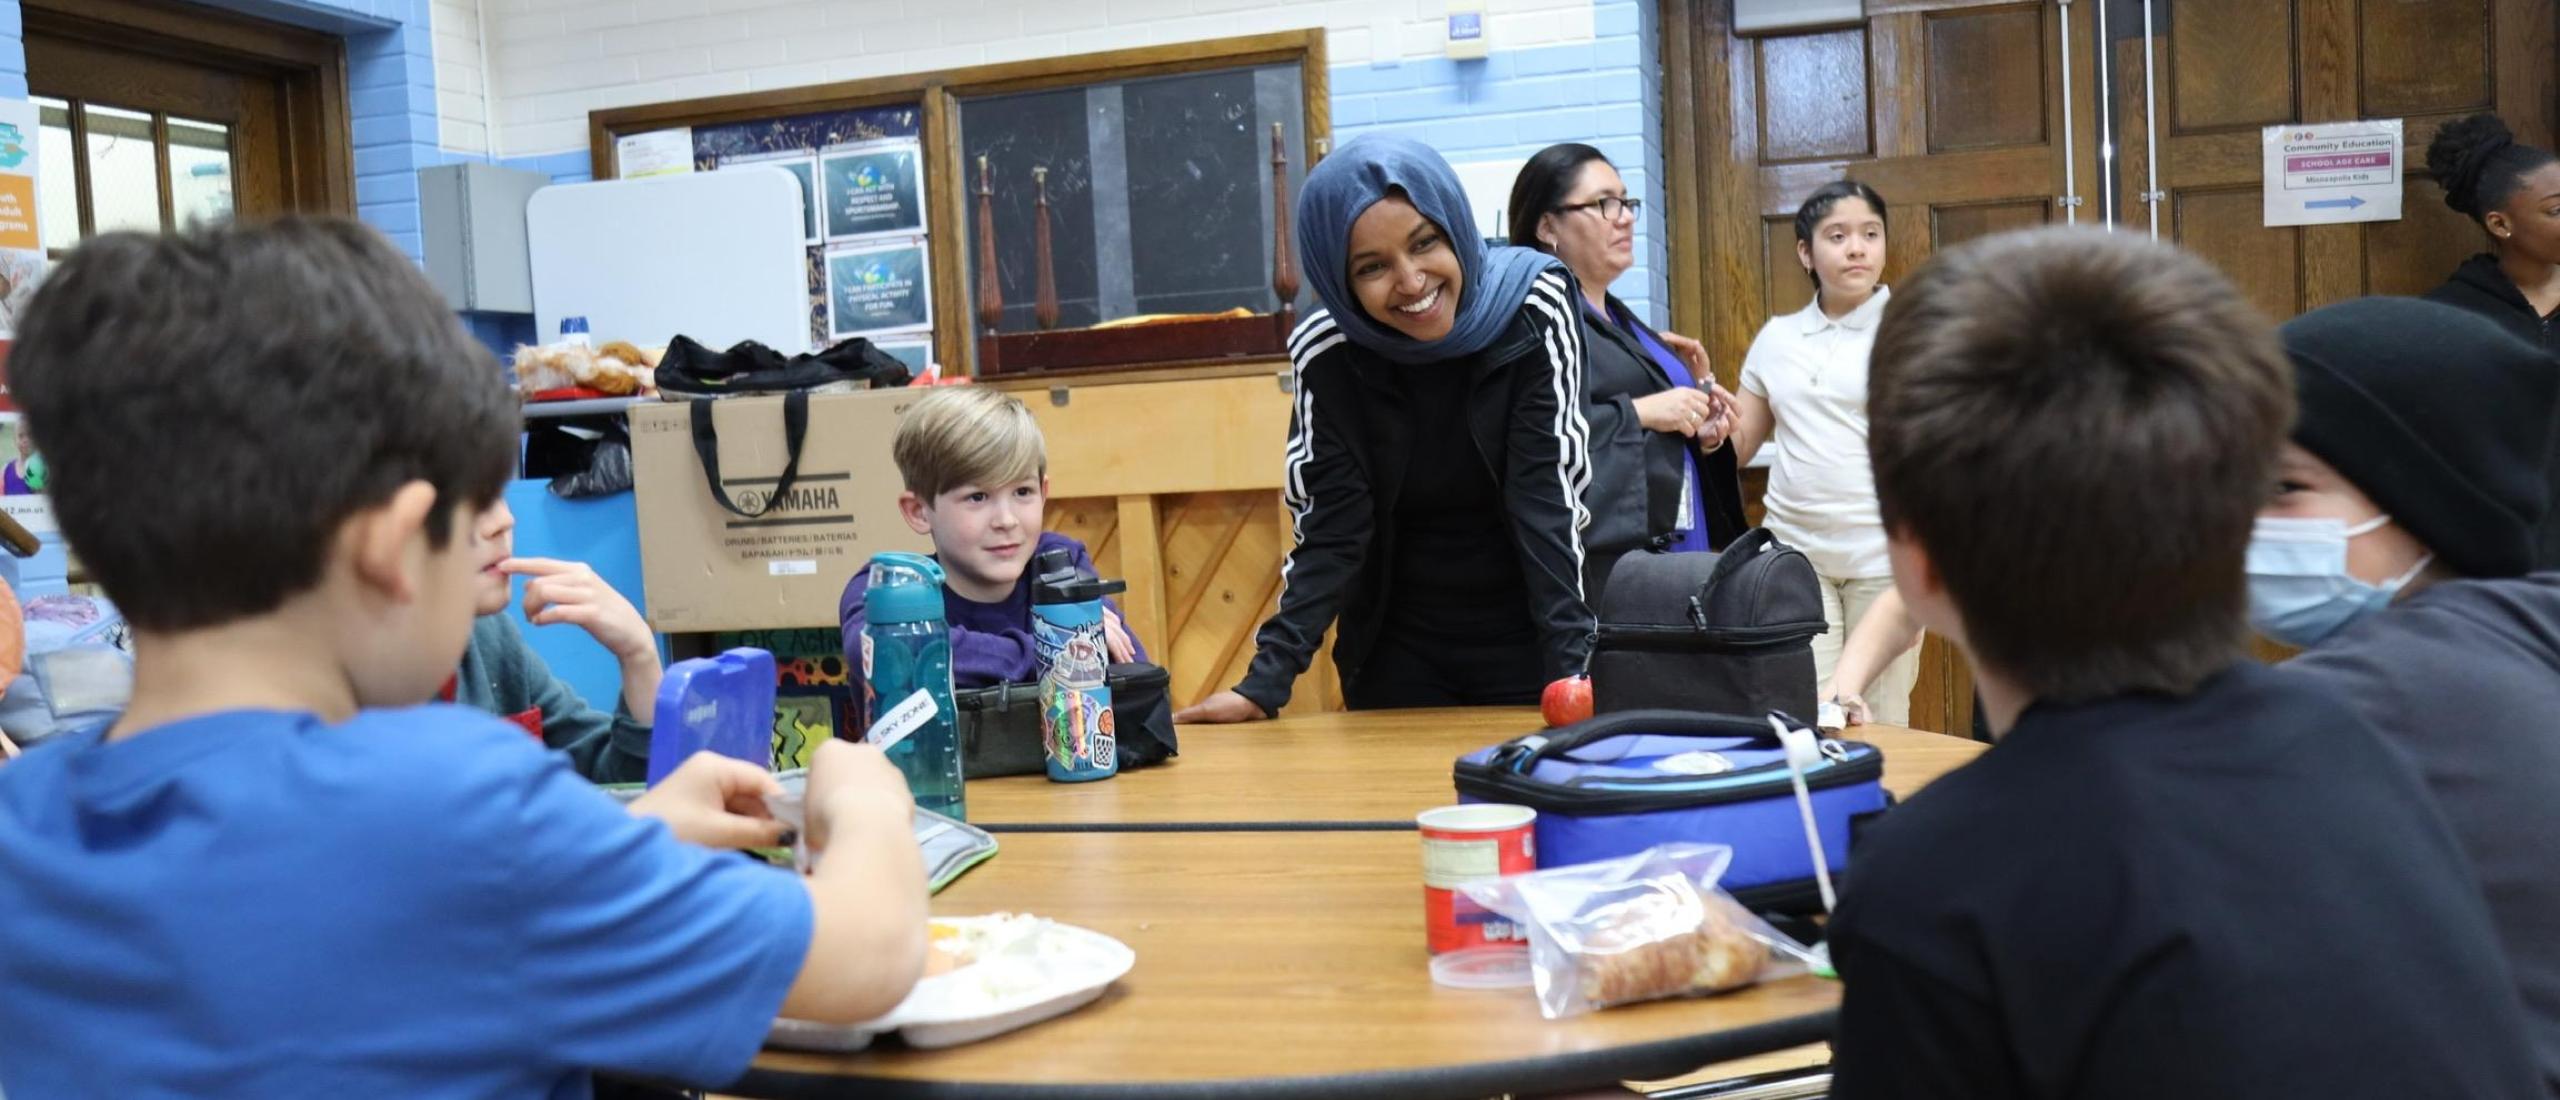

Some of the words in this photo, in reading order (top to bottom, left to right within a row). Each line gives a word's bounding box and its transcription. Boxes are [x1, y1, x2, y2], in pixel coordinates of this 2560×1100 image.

[2284, 142, 2339, 153] Community
[2342, 139, 2391, 149] Education
[2301, 159, 2334, 168] SCHOOL
[2336, 158, 2352, 166] AGE
[2354, 156, 2376, 164] CARE
[2306, 175, 2351, 184] Minneapolis
[2353, 173, 2369, 181] Kids
[880, 720, 899, 738] SKY
[901, 698, 930, 724] ZONE
